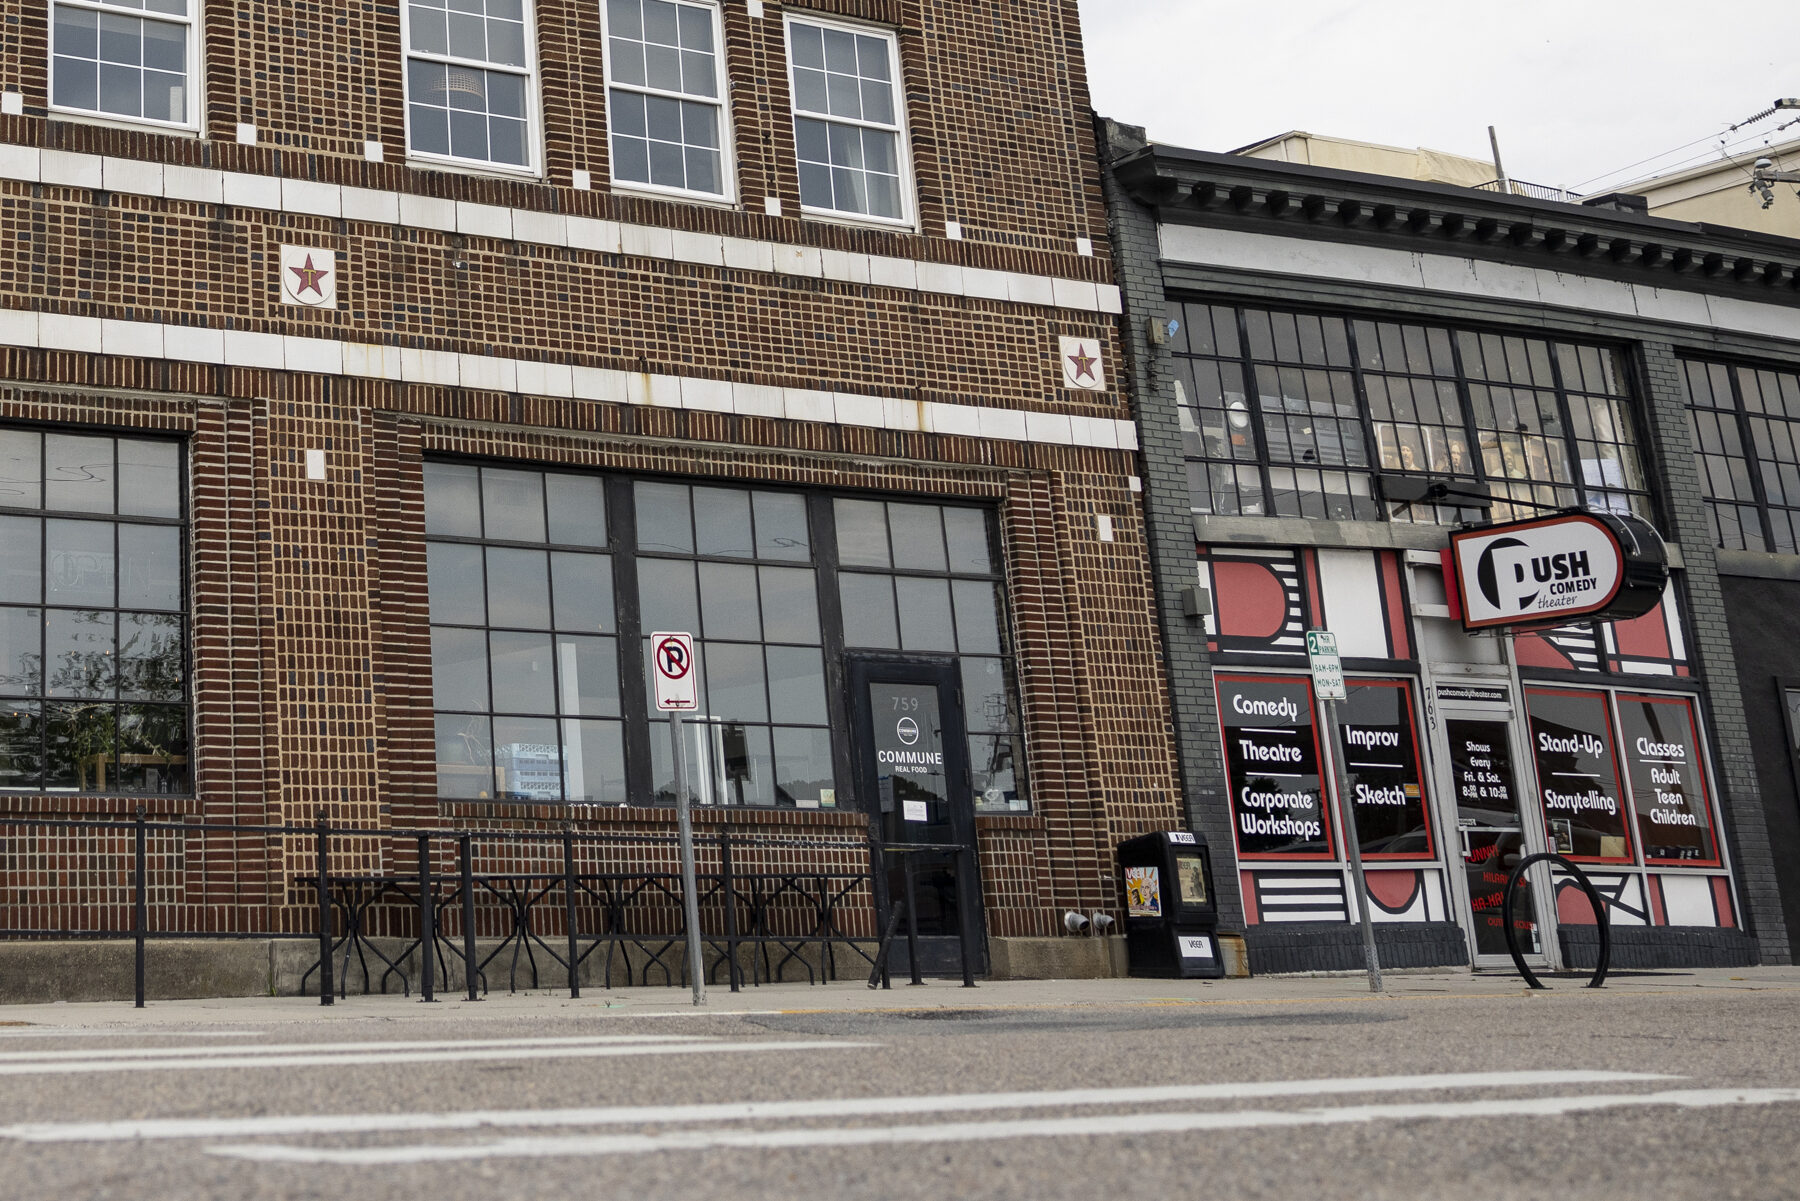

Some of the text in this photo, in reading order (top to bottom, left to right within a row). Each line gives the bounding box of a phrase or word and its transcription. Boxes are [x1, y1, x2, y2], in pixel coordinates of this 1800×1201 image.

[1550, 577, 1597, 595] COMEDY
[1538, 594, 1579, 609] theater
[1309, 636, 1318, 653] 2
[1319, 645, 1337, 654] PARKING
[1316, 679, 1341, 687] MON-SAT
[1437, 688, 1503, 699] pushcomedytheater.com
[891, 697, 919, 711] 759
[1233, 694, 1298, 722] Comedy
[1345, 725, 1399, 750] Improv
[1538, 732, 1603, 758] Stand-Up
[1239, 739, 1302, 762] Theatre
[1466, 741, 1491, 752] Shows
[1636, 737, 1685, 757] Classes
[878, 750, 942, 765] COMMUNE
[1470, 757, 1491, 770] Every
[895, 765, 928, 774] REAL FOOD
[1463, 771, 1501, 783] Fri. & Sat.
[1650, 768, 1682, 785] Adult
[1241, 786, 1313, 814] Corporate
[1355, 784, 1406, 806] Sketch
[1480, 787, 1488, 797] &
[1654, 788, 1684, 805] Teen
[1544, 789, 1616, 816] Storytelling
[1650, 808, 1696, 826] Children
[1240, 813, 1321, 842] Workshops
